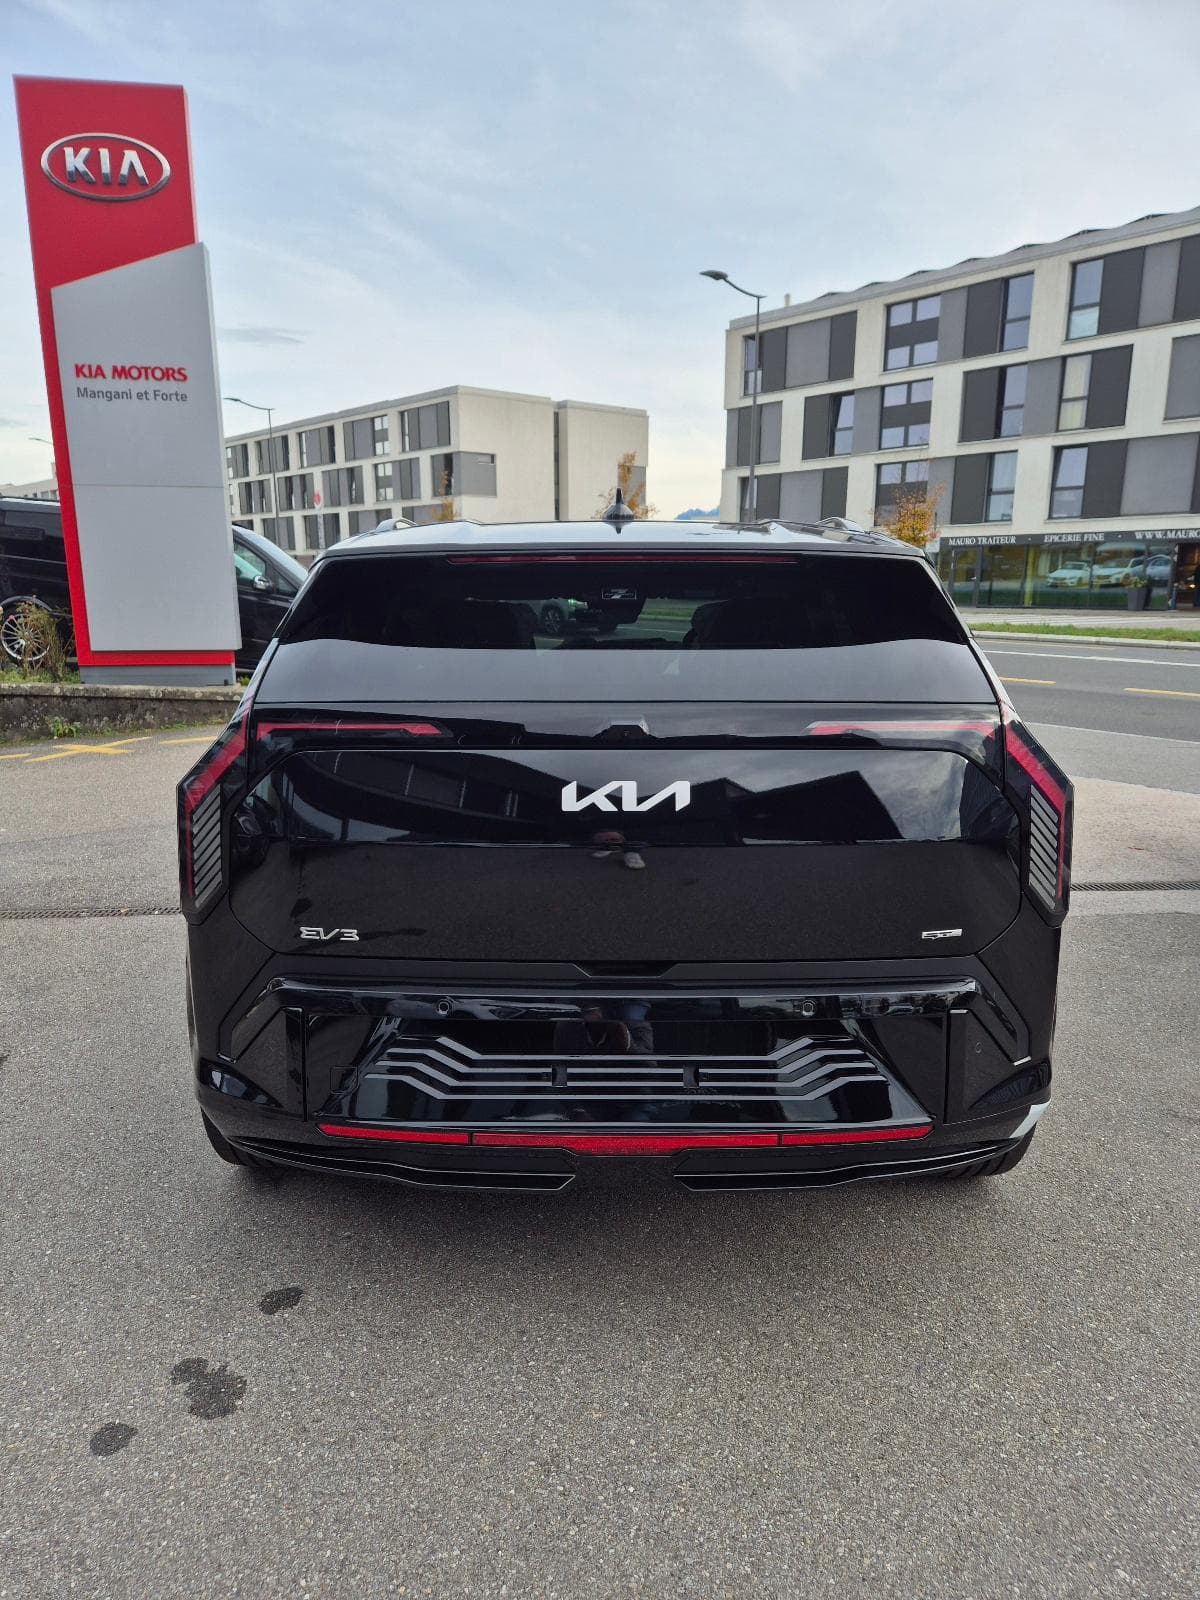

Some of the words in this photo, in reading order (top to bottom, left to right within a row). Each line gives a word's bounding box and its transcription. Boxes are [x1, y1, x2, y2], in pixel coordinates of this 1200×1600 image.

[62, 146, 149, 186] KIA
[75, 363, 106, 379] KIA
[112, 365, 188, 382] MOTORS
[77, 387, 132, 402] Mangani
[136, 390, 150, 401] et
[153, 390, 188, 402] Forte
[949, 537, 976, 545] MAURO
[978, 535, 1016, 545] TRAITEUR
[1044, 534, 1082, 543] EPICERIE
[1083, 533, 1105, 541] FINE
[561, 780, 691, 811] KIA
[300, 926, 360, 941] EV3
